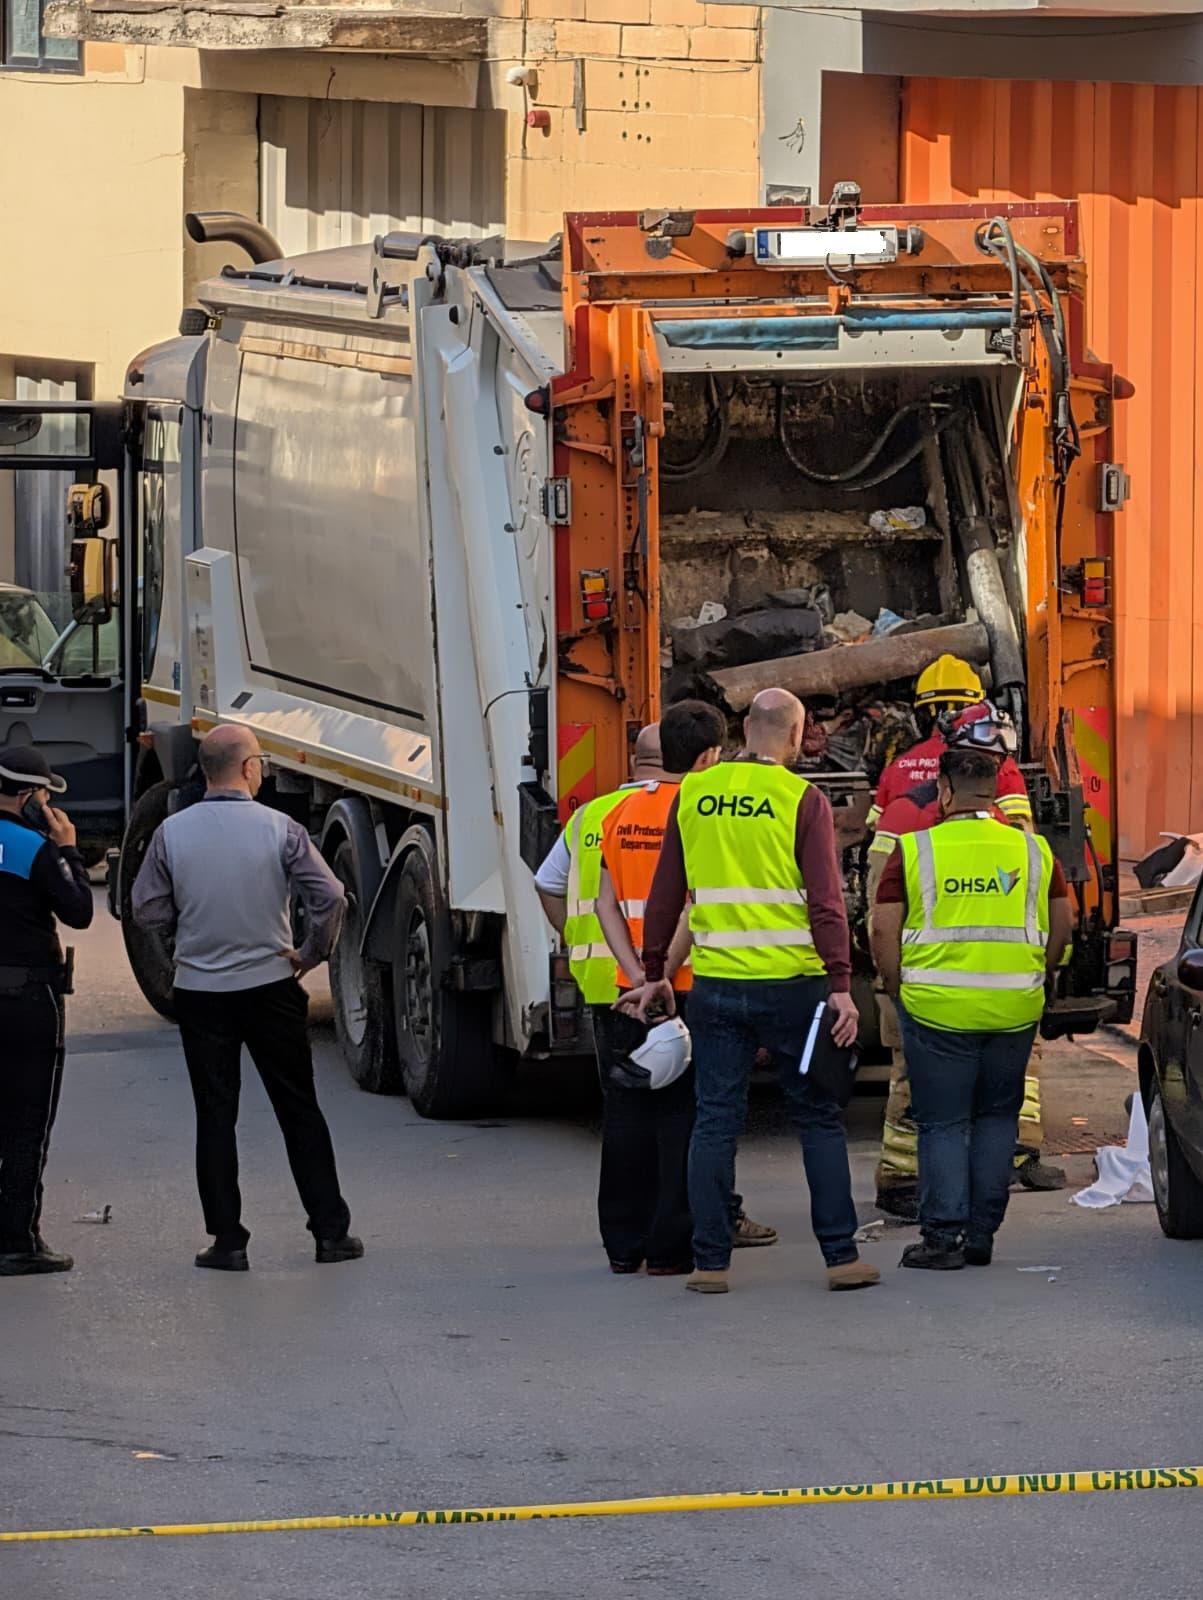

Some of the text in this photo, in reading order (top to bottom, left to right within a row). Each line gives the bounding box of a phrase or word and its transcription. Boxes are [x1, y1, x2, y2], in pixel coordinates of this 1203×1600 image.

[697, 794, 776, 819] OHSA
[944, 877, 1000, 893] OHSA
[964, 1476, 1007, 1493] DO
[1092, 1467, 1198, 1490] CROSS
